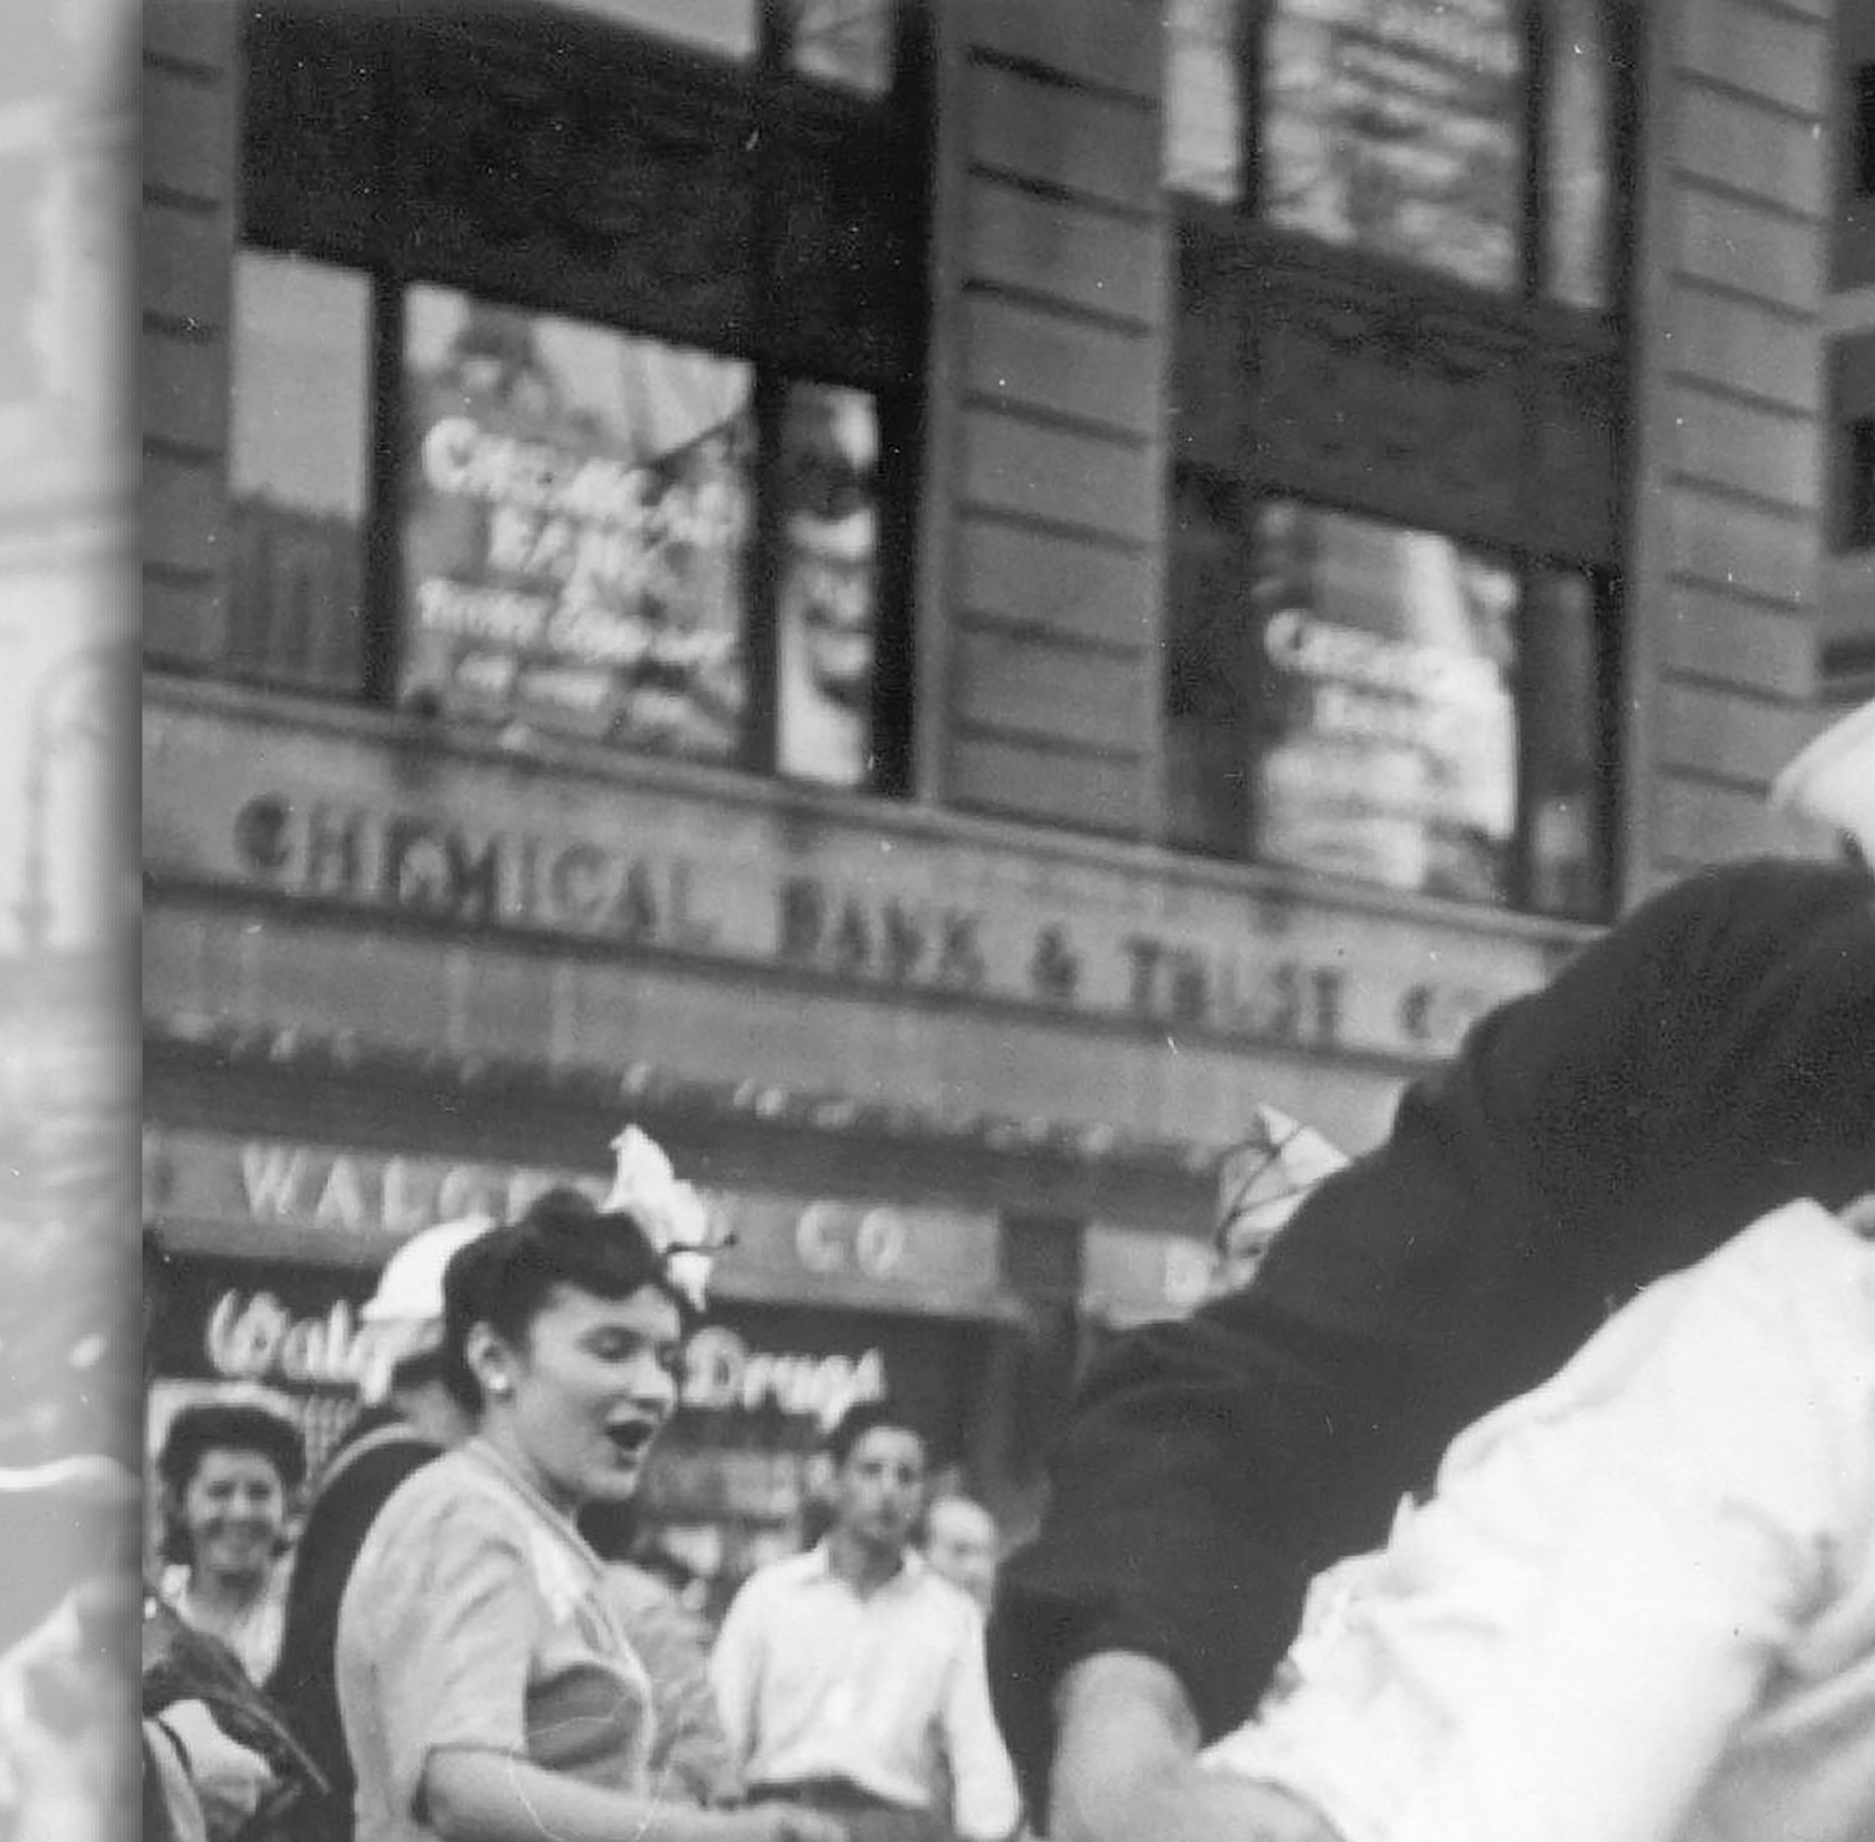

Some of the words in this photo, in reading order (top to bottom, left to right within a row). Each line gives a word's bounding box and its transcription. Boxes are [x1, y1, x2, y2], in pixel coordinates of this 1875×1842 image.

[235, 792, 722, 948] CHEMICAL
[780, 876, 986, 987] BANK
[1126, 935, 1344, 1050] TRUST
[795, 1200, 907, 1279] CO
[207, 1288, 395, 1405] Walg
[682, 1324, 887, 1435] Drugs
